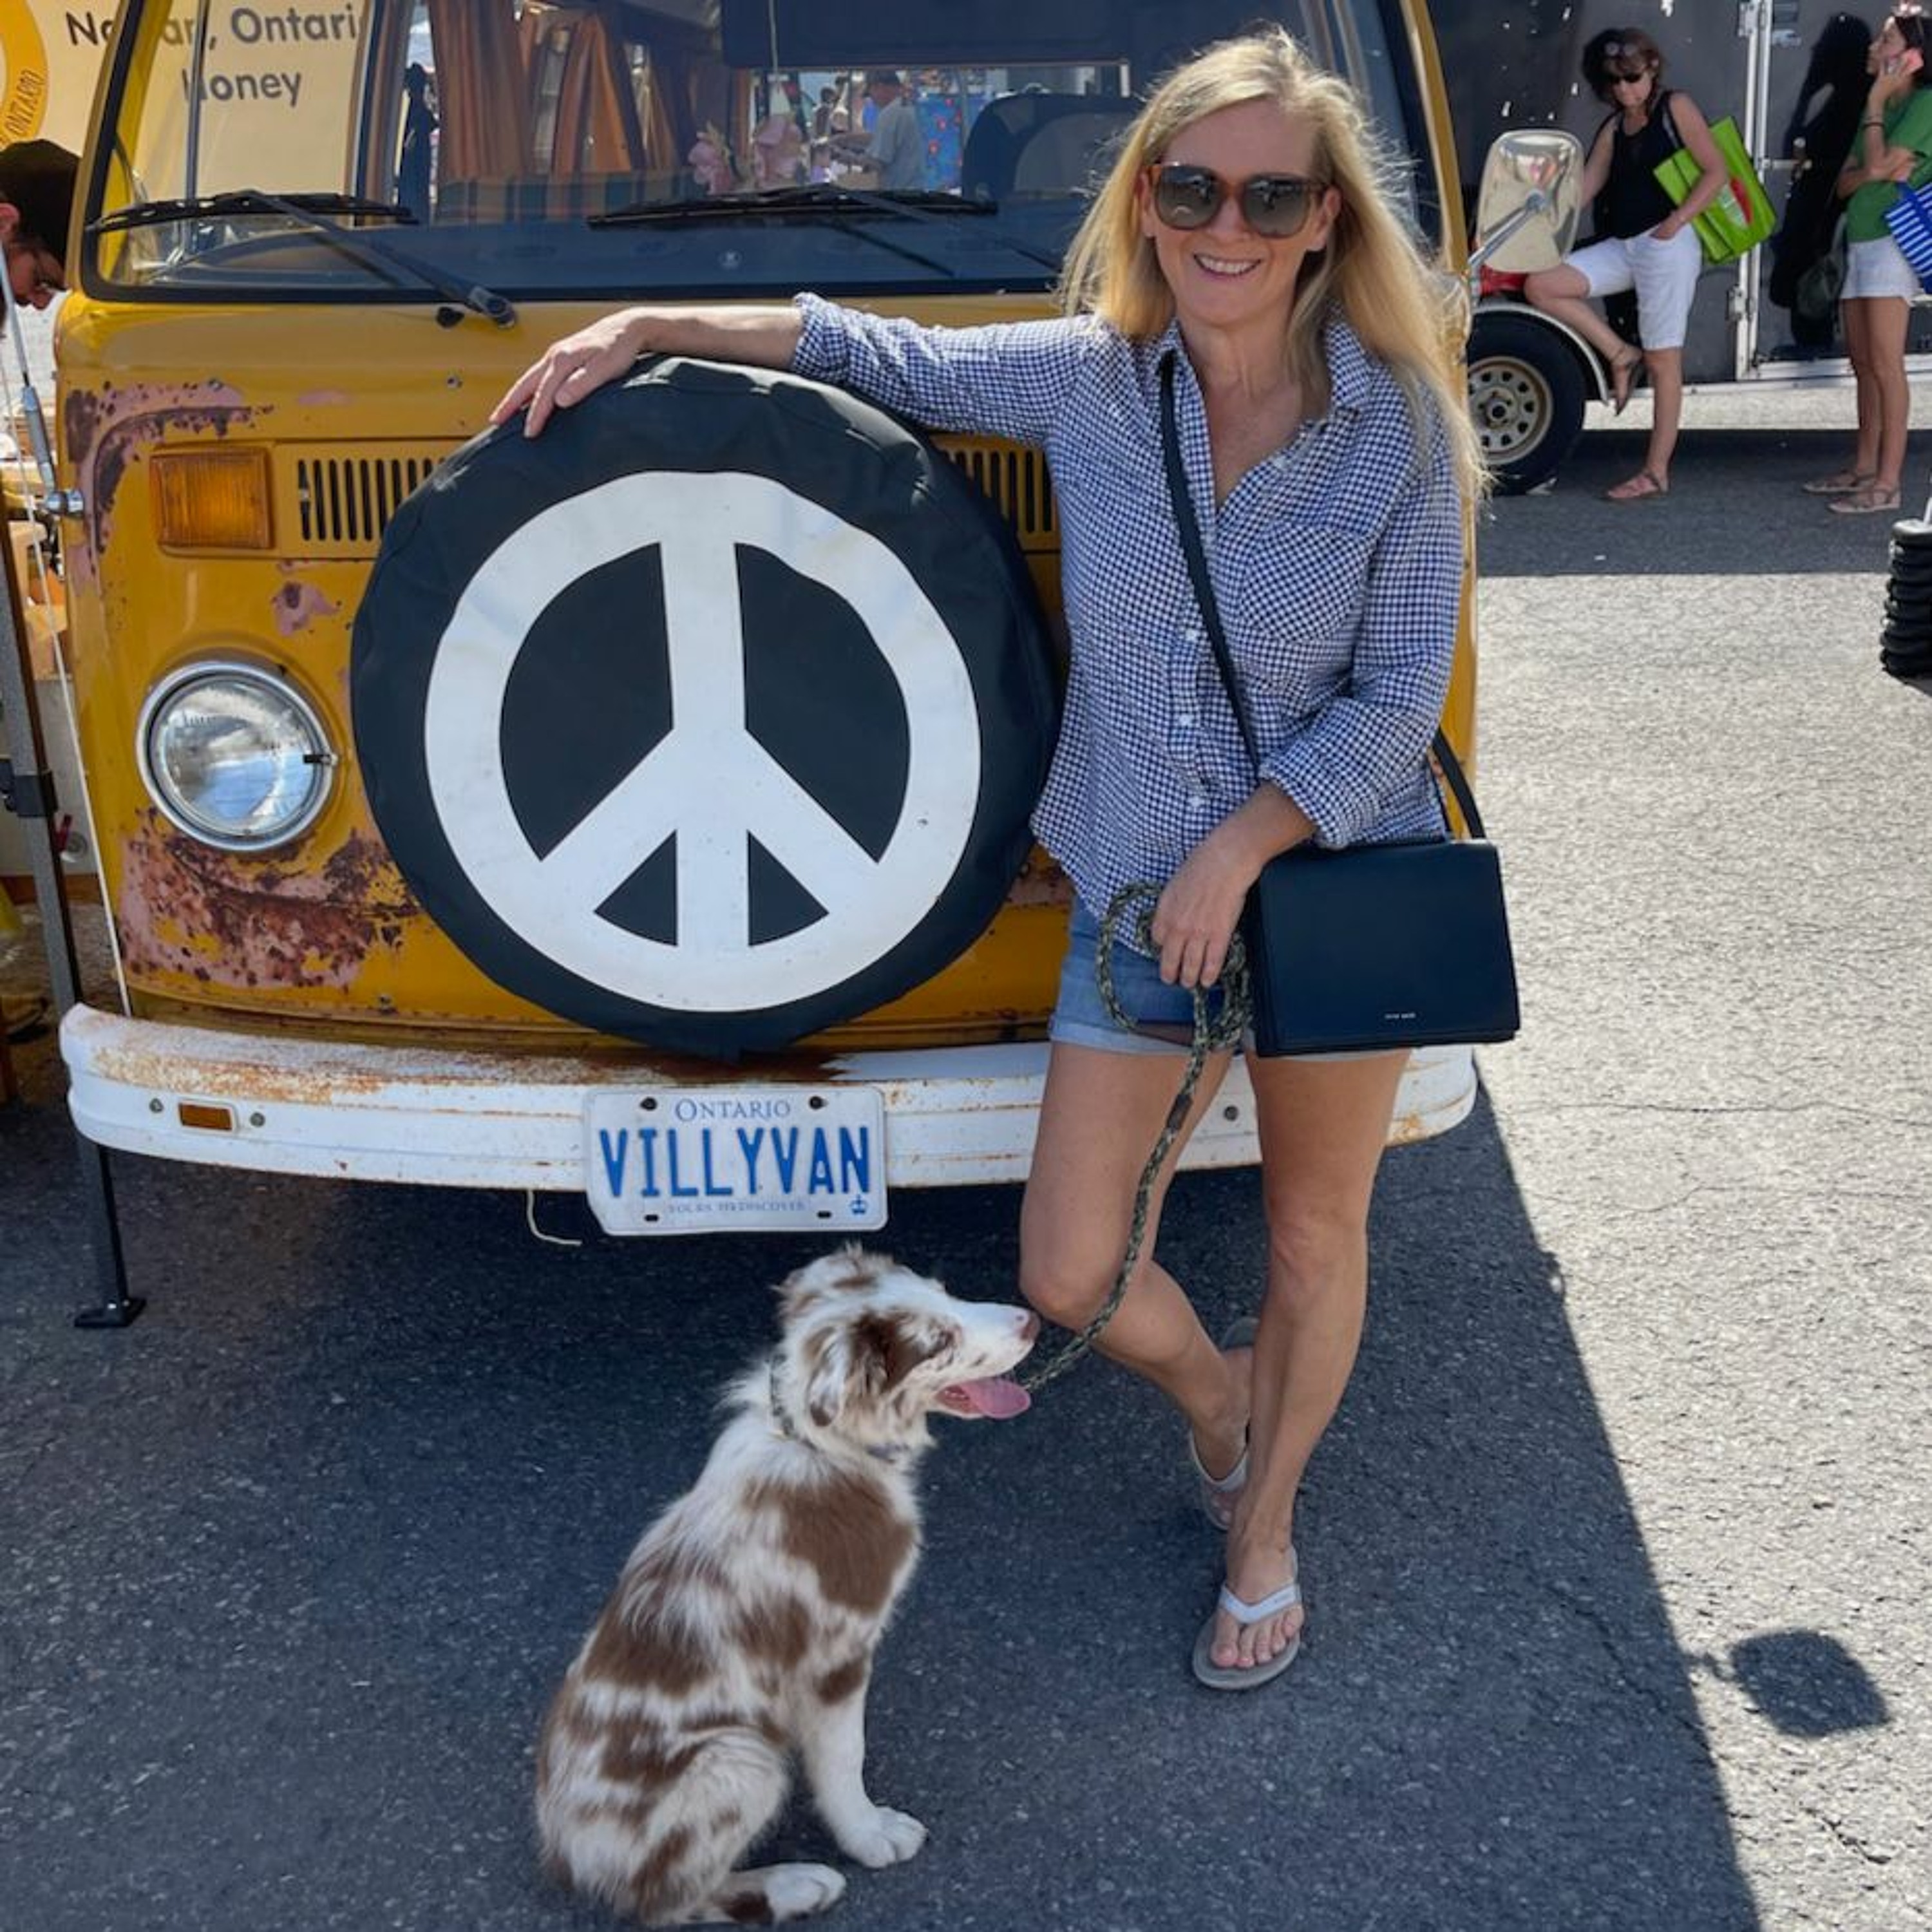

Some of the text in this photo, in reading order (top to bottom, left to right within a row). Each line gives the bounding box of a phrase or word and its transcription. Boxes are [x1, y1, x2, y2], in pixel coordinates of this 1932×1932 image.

[231, 3, 361, 44] Ontari
[675, 1099, 791, 1122] ONTARIO
[599, 1126, 869, 1197] VILLYVAN
